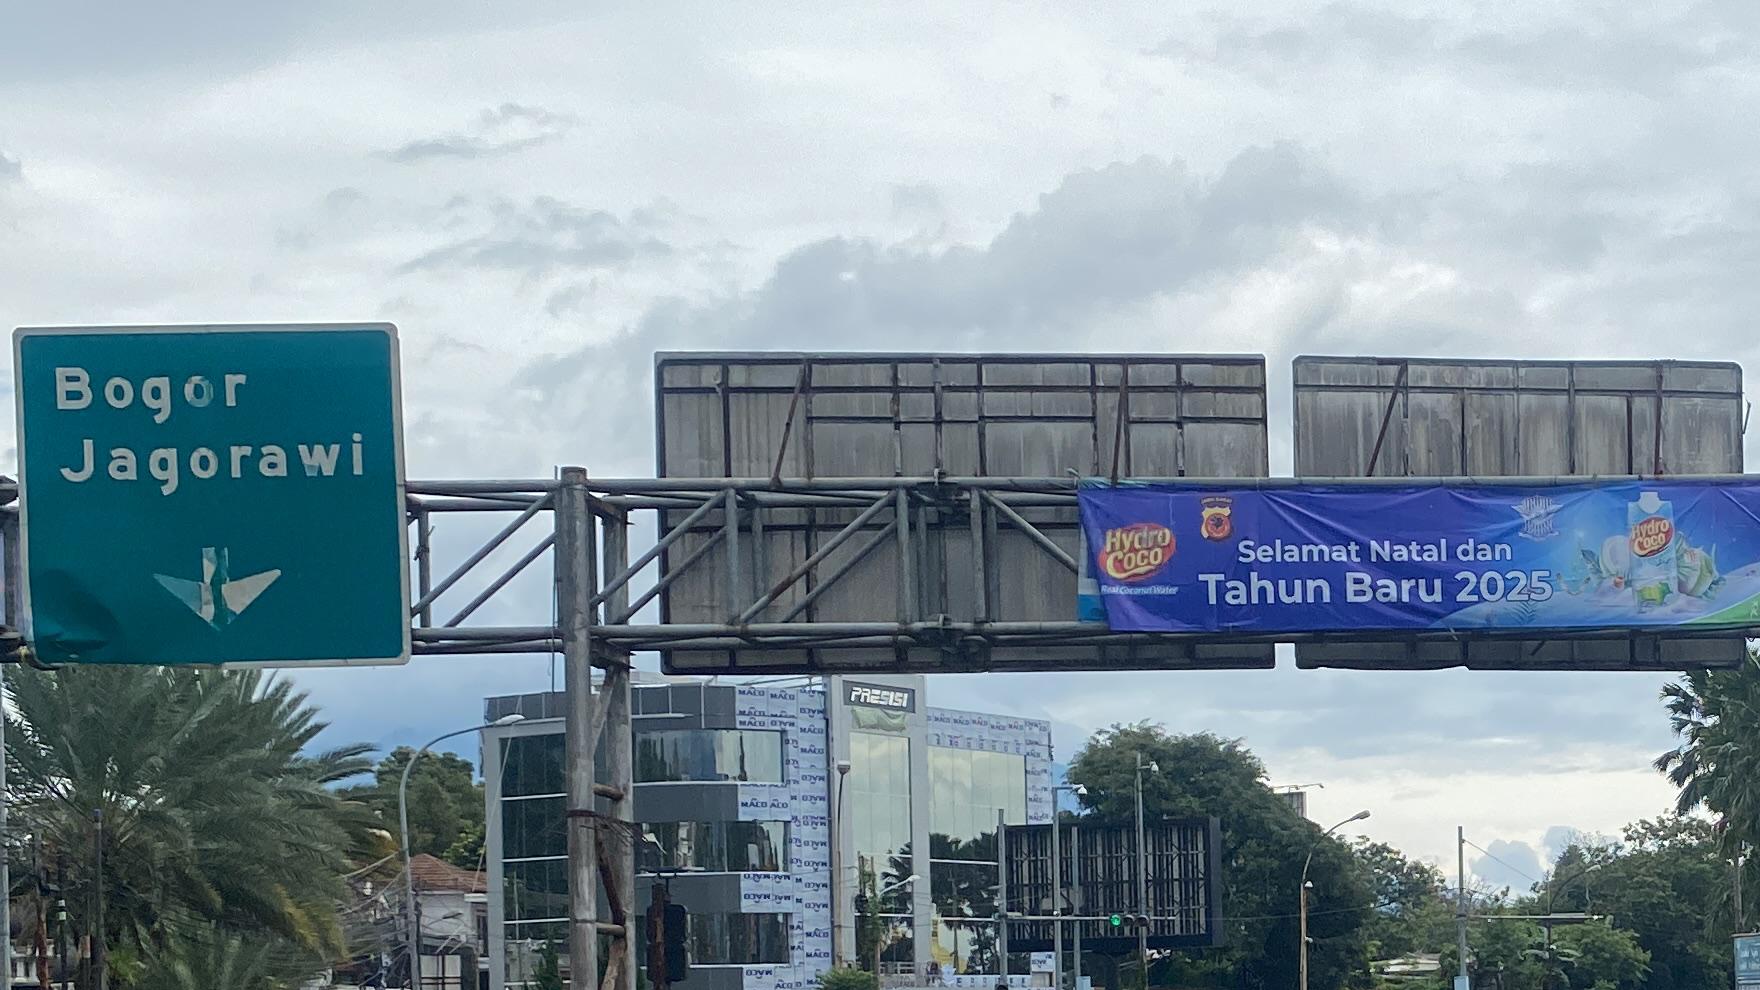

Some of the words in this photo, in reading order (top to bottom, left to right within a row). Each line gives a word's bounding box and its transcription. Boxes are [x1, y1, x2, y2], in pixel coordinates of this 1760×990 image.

[55, 367, 248, 423] Bogor
[60, 433, 364, 496] Jagorawi
[1106, 526, 1171, 553] Hydro
[1632, 519, 1670, 541] Hydro
[1238, 538, 1361, 563] Selamat
[1369, 538, 1447, 563] Natal
[1456, 538, 1512, 562] dan
[1634, 535, 1667, 555] Coco
[1106, 548, 1163, 579] Coco
[1101, 585, 1119, 594] Real
[1120, 585, 1153, 594] Coconut
[1153, 585, 1178, 595] Water
[1198, 571, 1331, 605] Tahun
[1345, 571, 1443, 604] Baru
[1454, 570, 1552, 602] 2025
